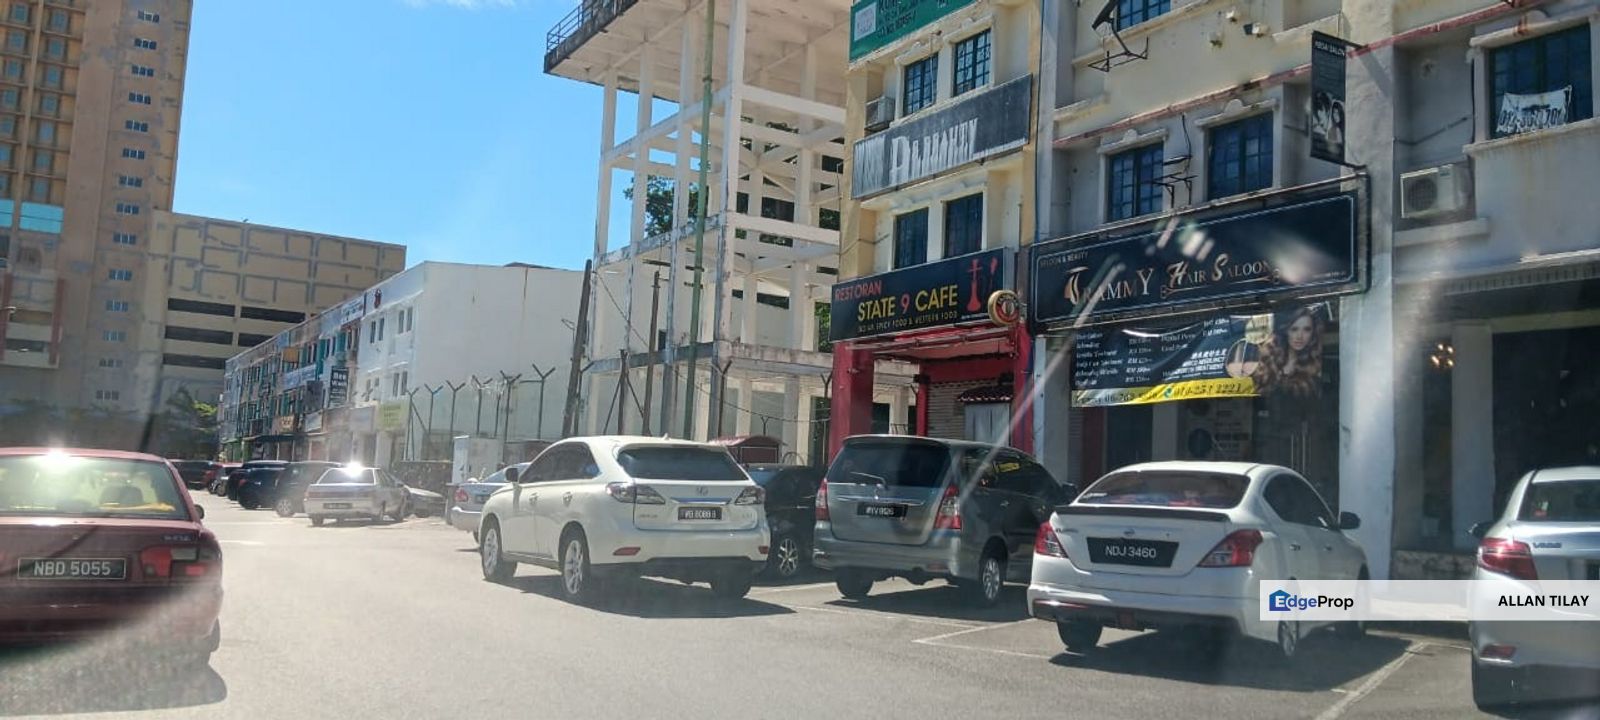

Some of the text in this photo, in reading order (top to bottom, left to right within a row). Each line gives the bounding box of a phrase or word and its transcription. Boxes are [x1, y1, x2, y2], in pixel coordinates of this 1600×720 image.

[834, 280, 882, 301] RESTORAN
[857, 284, 959, 322] STATE 9 CAFE
[1105, 545, 1157, 559] NDJ 3460
[33, 561, 112, 576] NBD 5055
